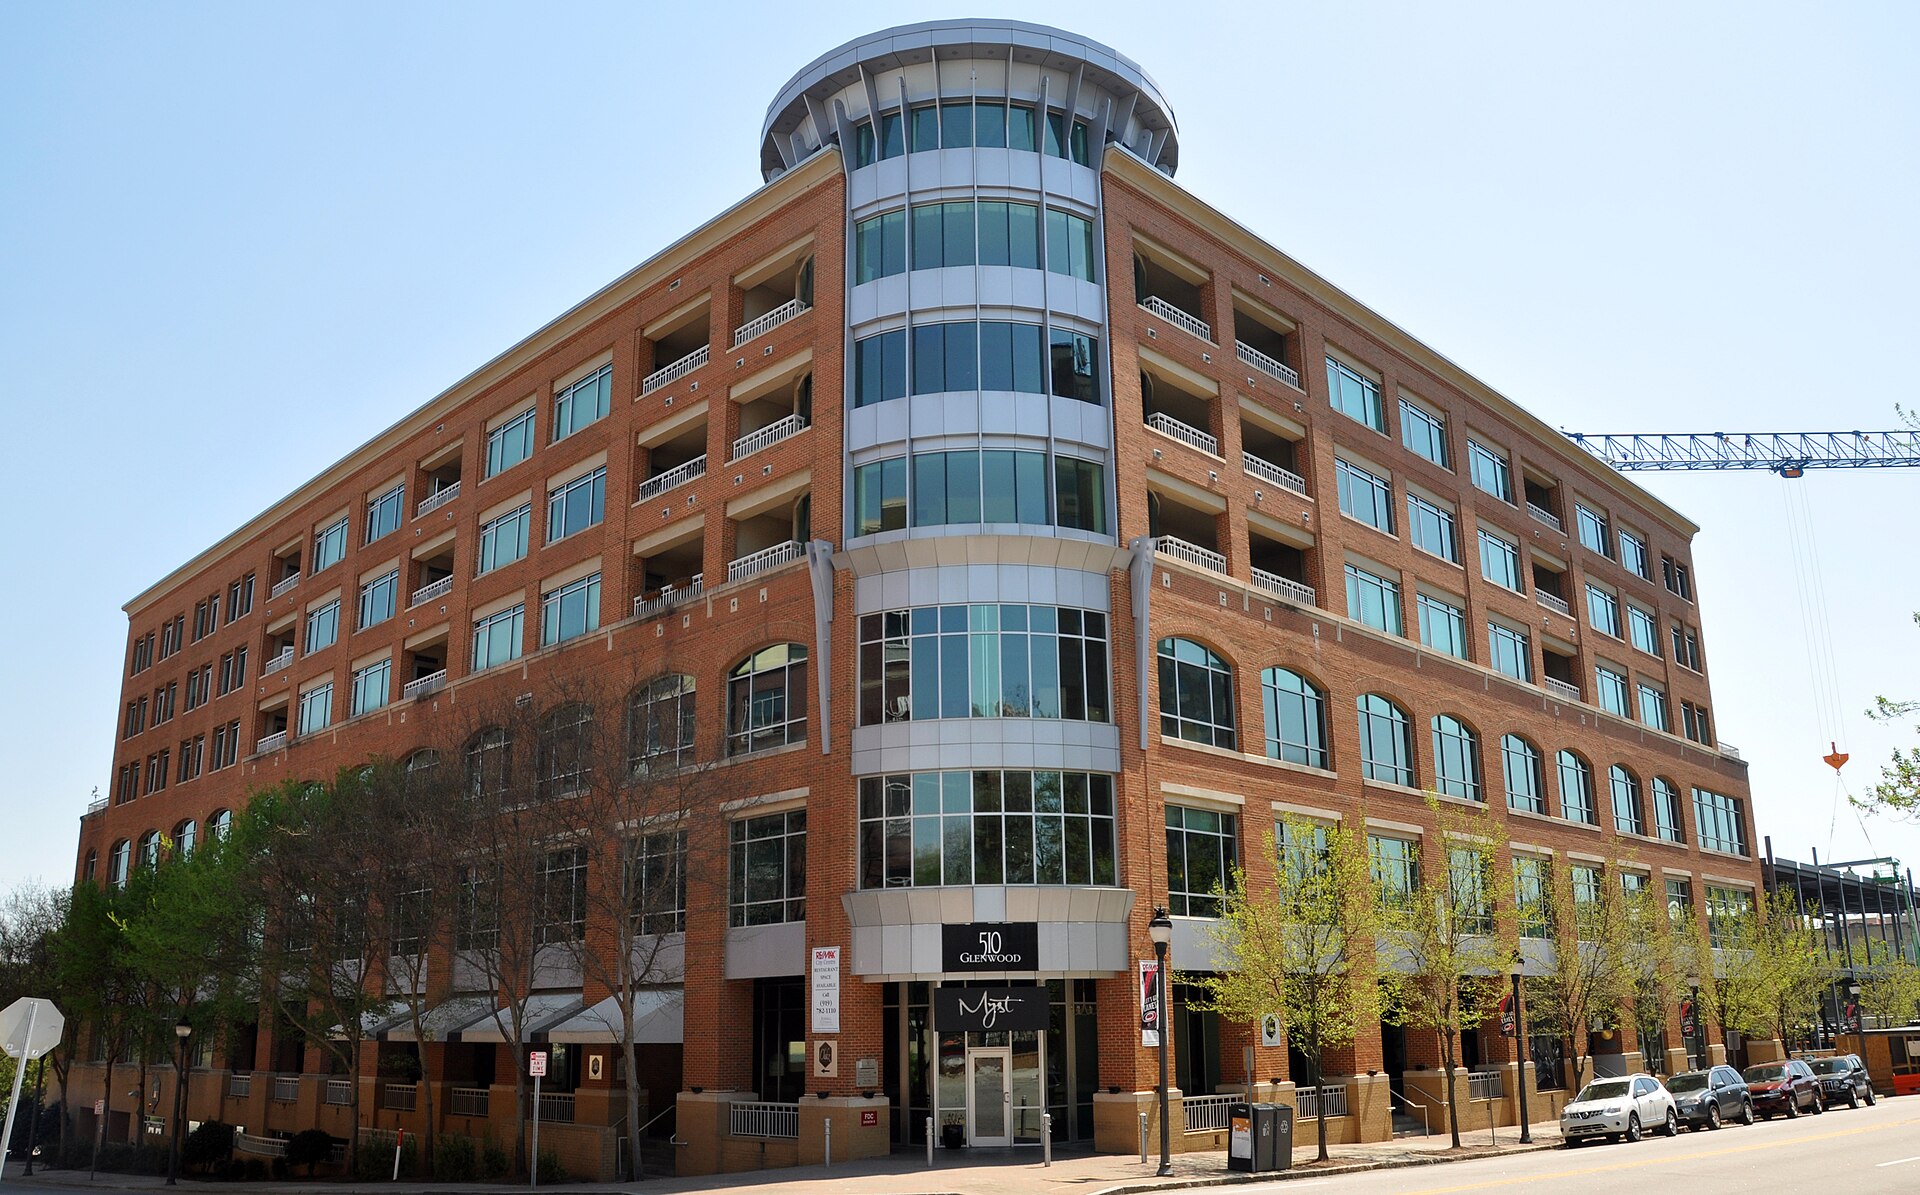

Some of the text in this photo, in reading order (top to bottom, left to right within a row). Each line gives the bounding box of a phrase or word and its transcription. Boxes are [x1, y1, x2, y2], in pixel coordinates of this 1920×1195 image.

[979, 931, 1002, 957] 510
[816, 951, 836, 960] RE/MAX
[959, 952, 1022, 963] GLENWOOD
[958, 990, 1025, 1029] Myst
